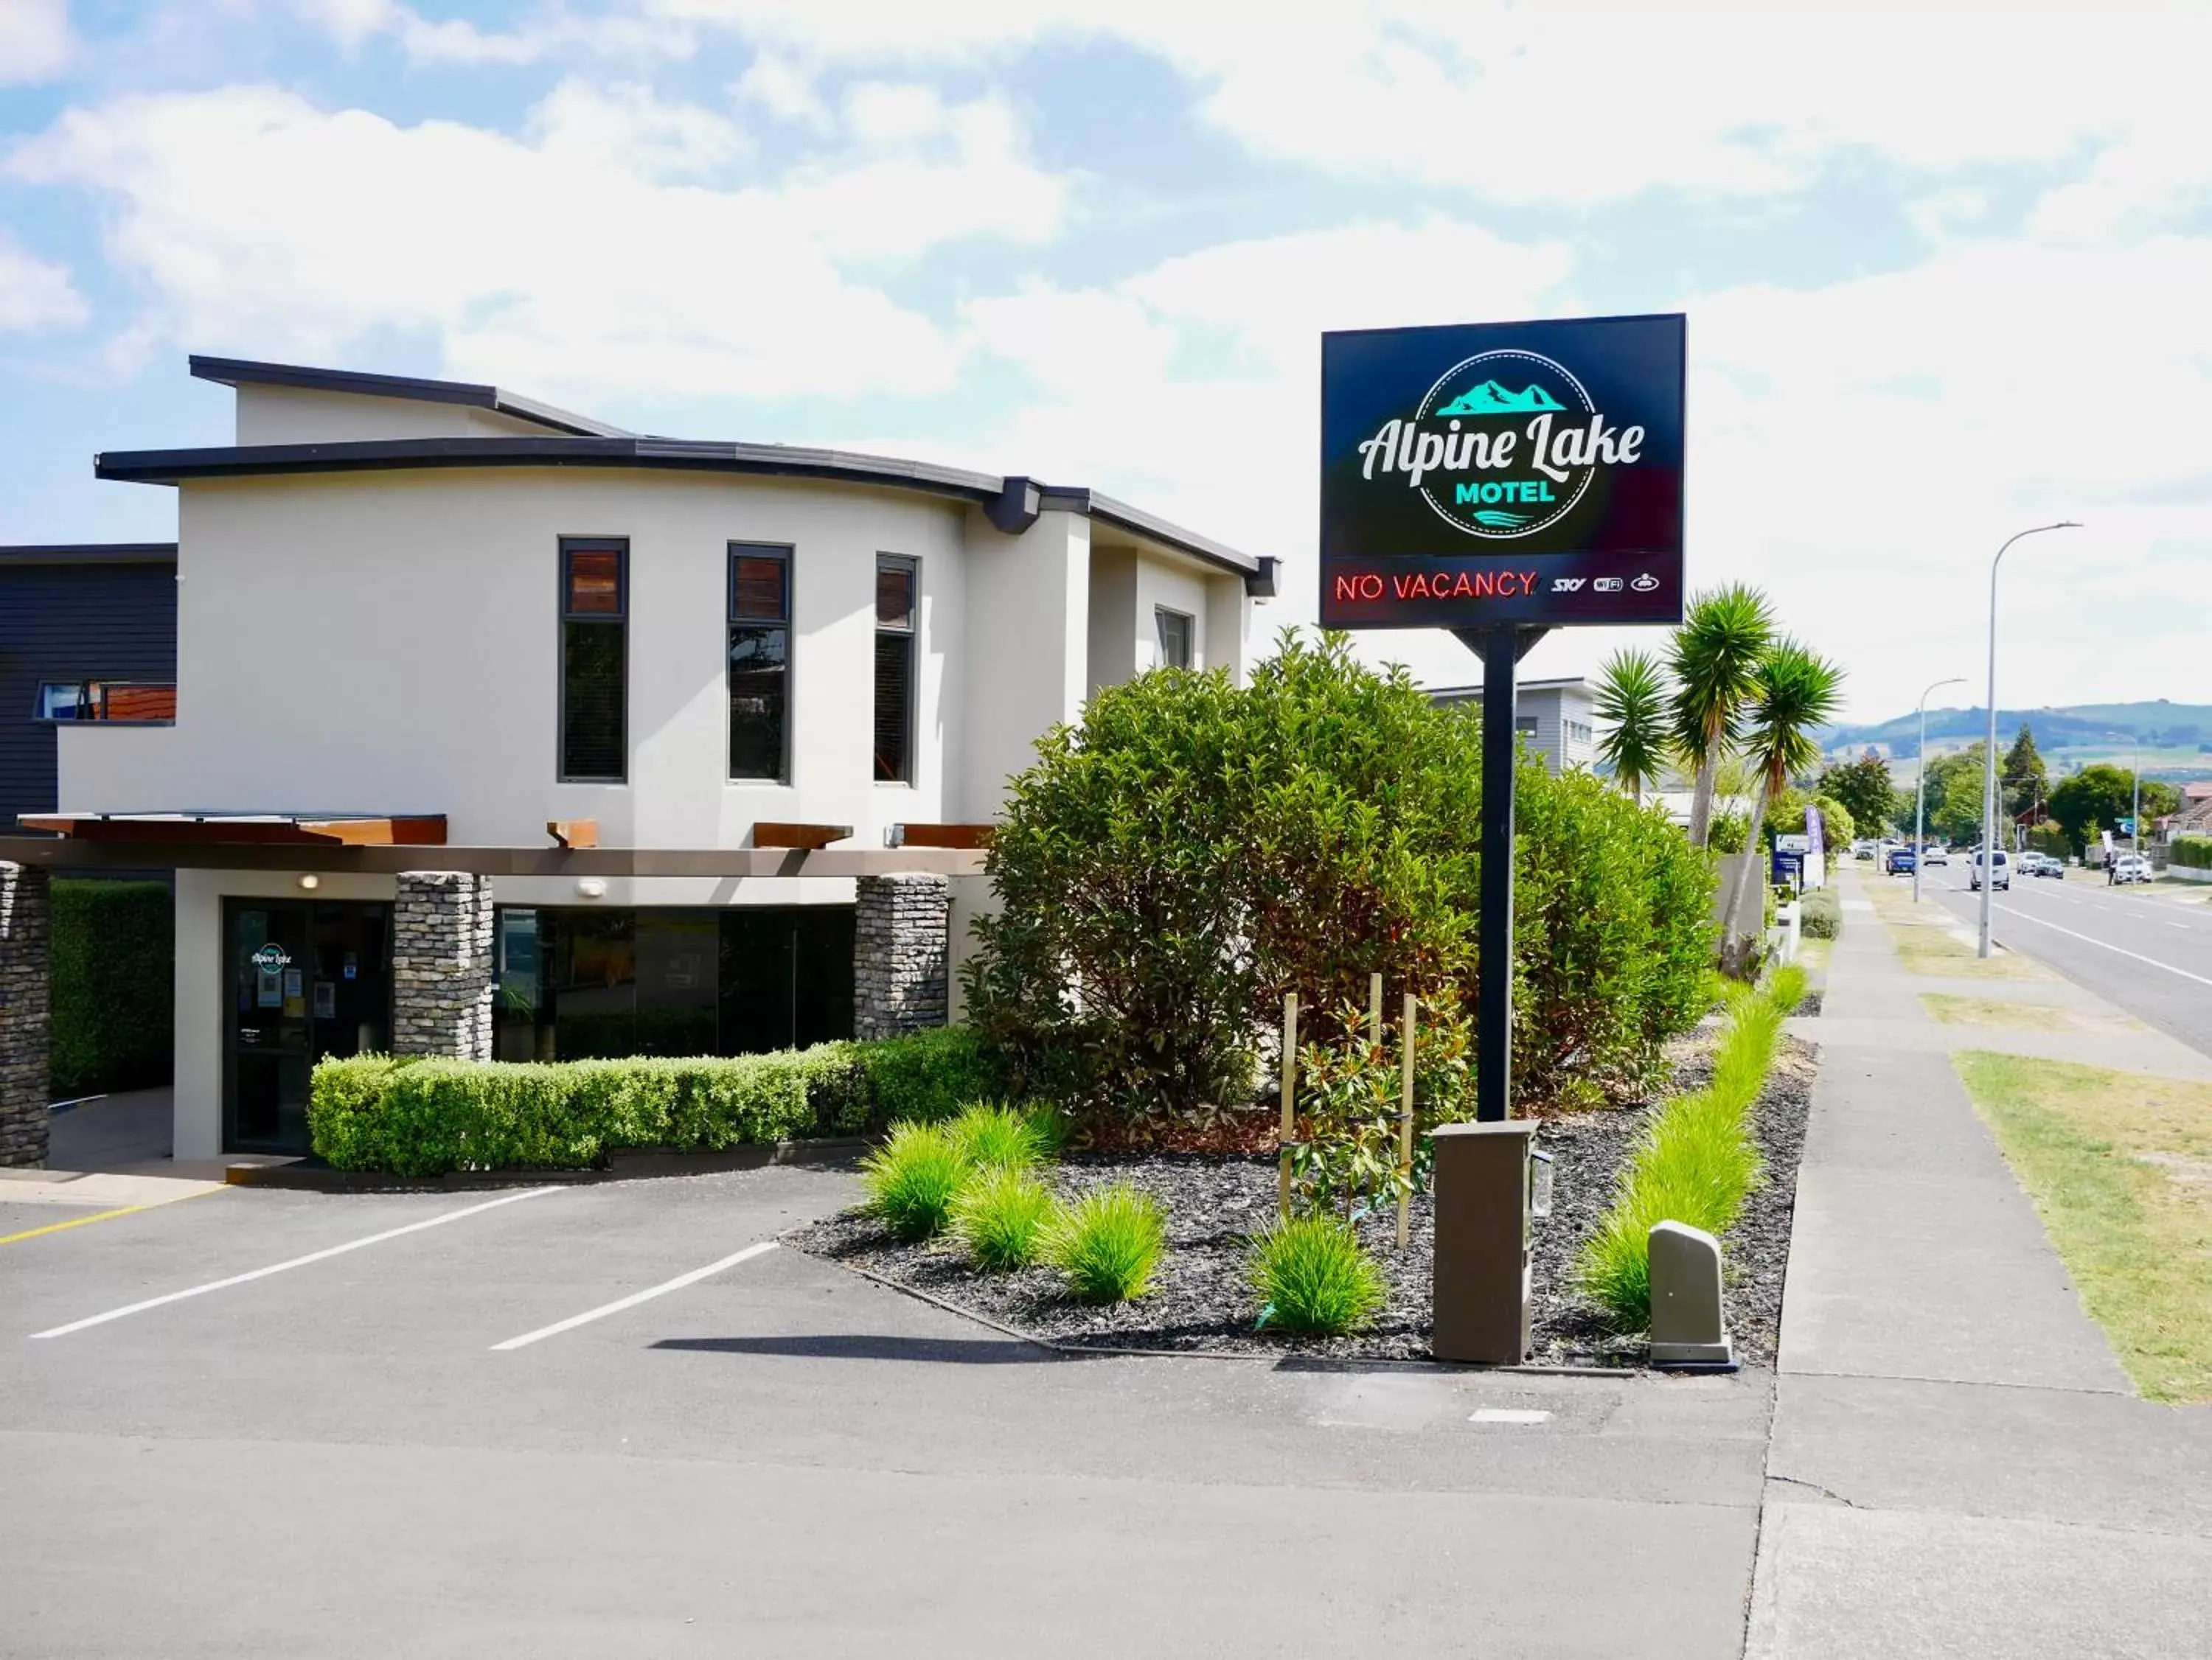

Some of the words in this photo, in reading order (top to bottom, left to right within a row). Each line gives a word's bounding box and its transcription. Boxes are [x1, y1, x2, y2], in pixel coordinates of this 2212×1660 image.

[1358, 419, 1517, 487] Alpine
[1526, 413, 1645, 483] Lake
[1455, 481, 1555, 504] MOTEL
[1336, 574, 1383, 601] NO
[1393, 571, 1537, 600] VACANCY
